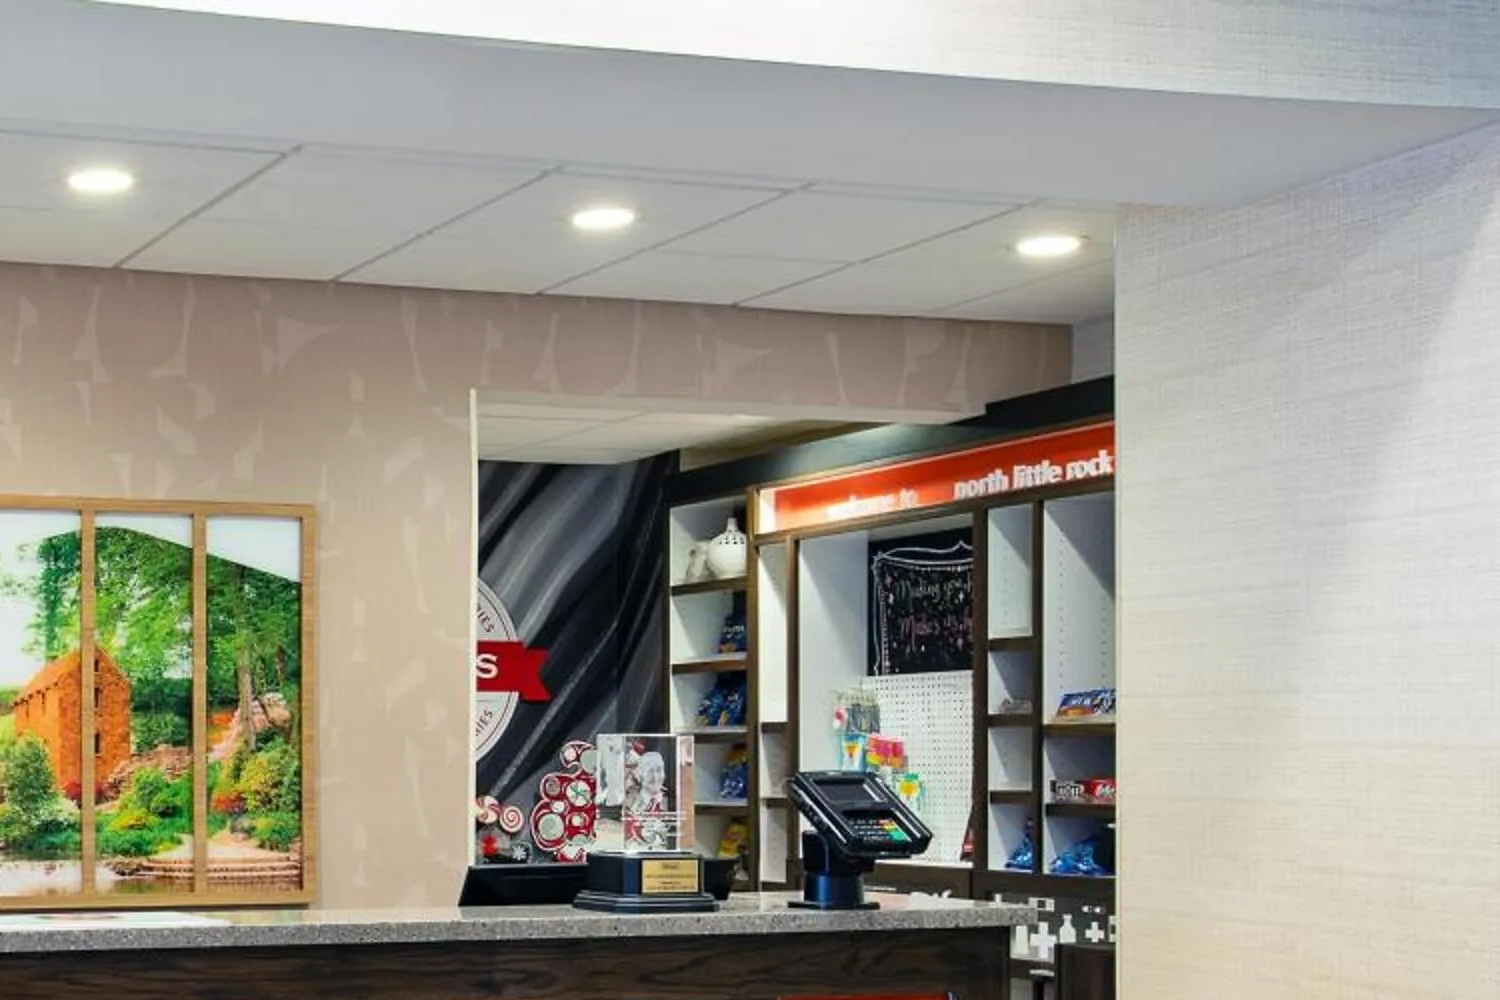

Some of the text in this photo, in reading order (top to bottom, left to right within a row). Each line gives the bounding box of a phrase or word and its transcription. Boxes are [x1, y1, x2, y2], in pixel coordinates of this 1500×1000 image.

[953, 449, 1114, 500] north little rock
